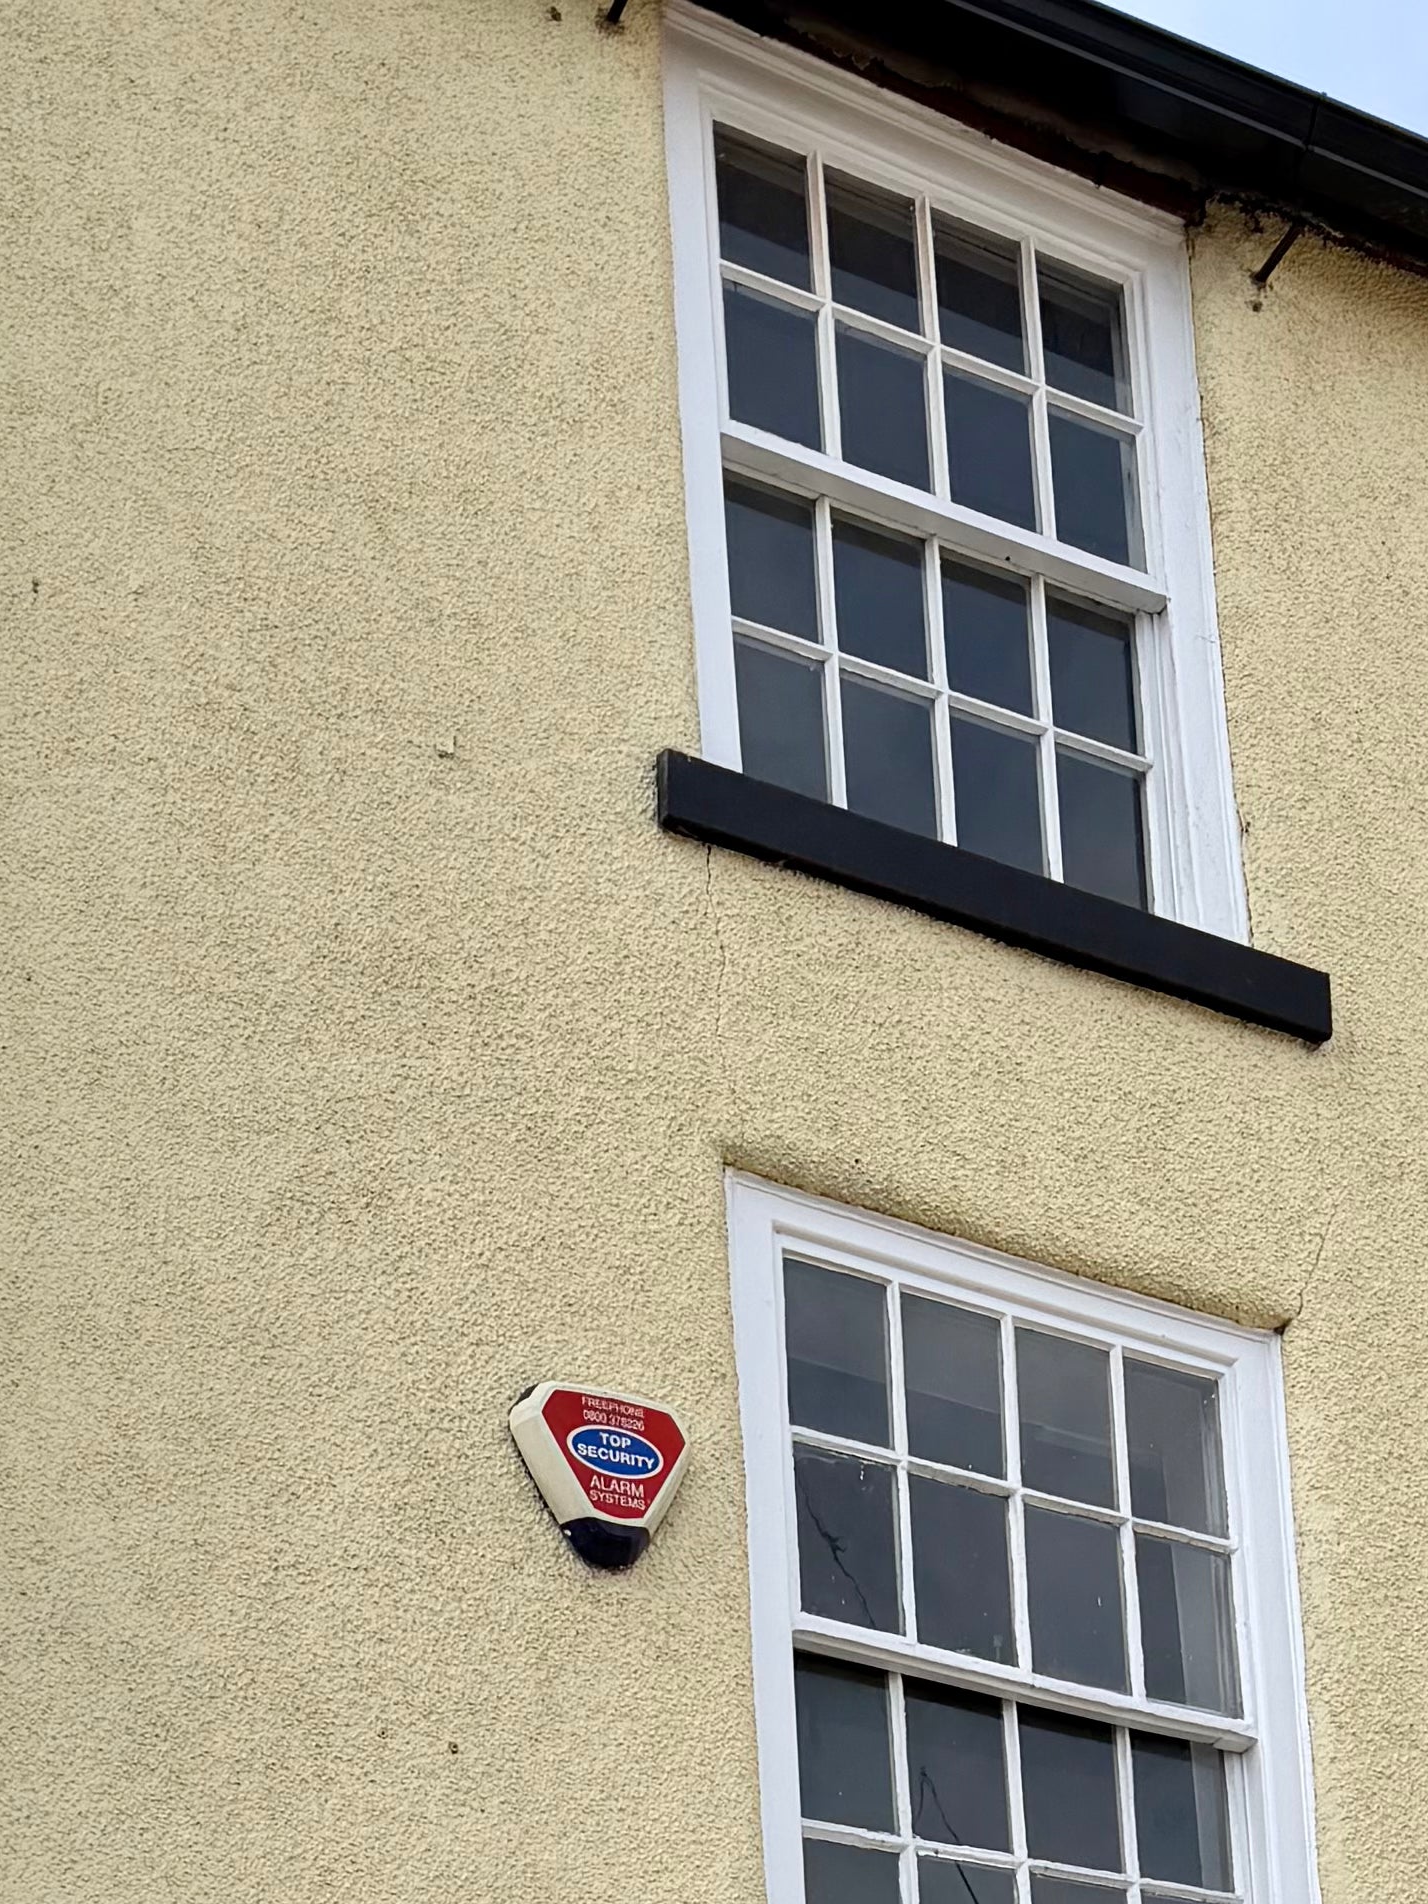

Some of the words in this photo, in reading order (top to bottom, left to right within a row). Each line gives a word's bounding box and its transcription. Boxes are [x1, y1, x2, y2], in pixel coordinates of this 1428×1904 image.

[581, 1395, 645, 1418] FREEPHONE
[583, 1409, 607, 1424] 0800
[599, 1431, 632, 1448] TOP
[577, 1443, 655, 1470] SECURITY
[590, 1475, 644, 1498] ALARM
[589, 1489, 646, 1511] SYSTEMS
